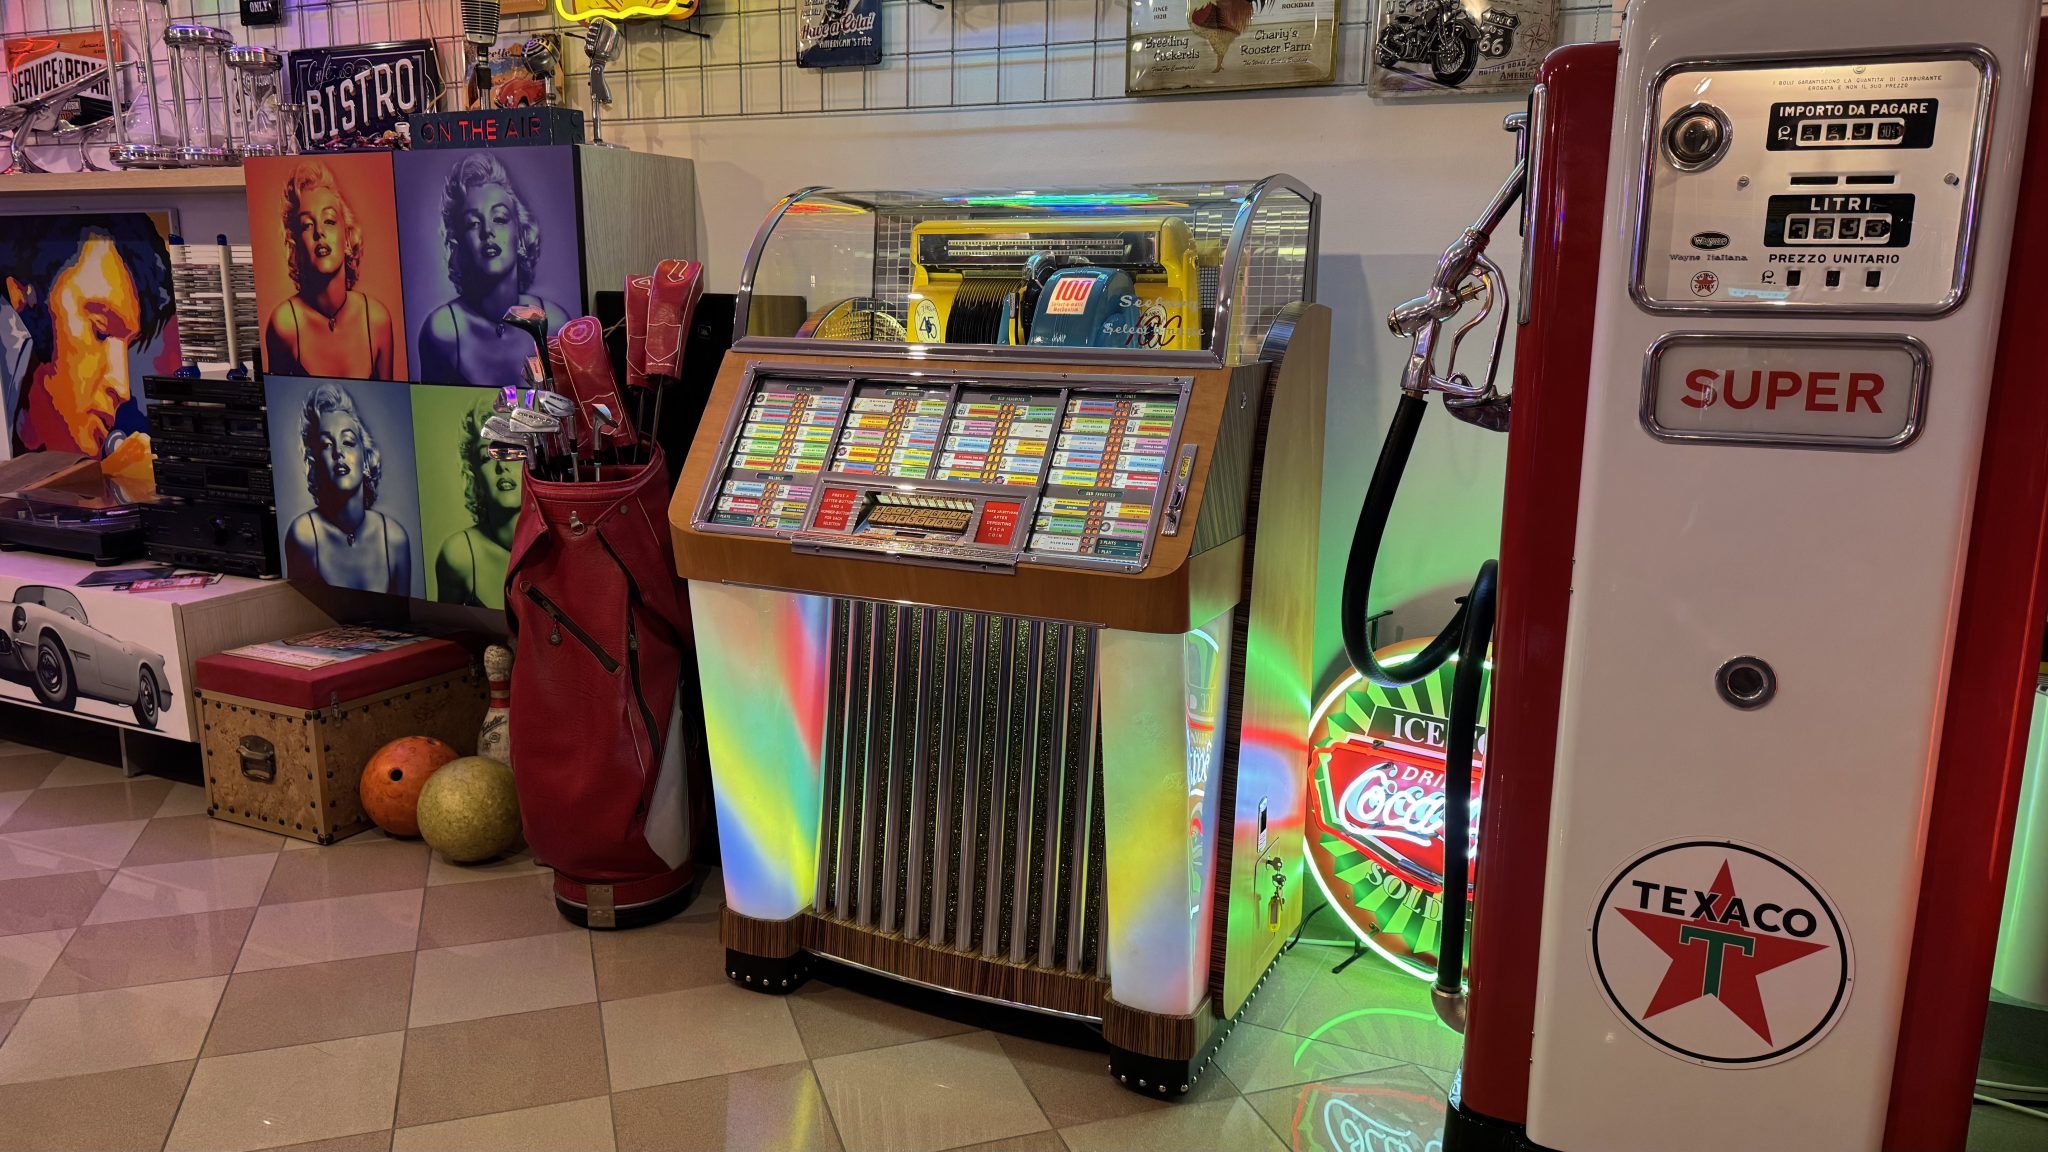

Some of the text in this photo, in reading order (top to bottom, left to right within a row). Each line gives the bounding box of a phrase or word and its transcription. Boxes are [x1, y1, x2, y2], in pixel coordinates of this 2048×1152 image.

[250, 1, 268, 12] ONLY
[802, 23, 830, 39] Have
[840, 12, 876, 34] Cola!
[1490, 14, 1514, 26] ROUTE
[1145, 36, 1190, 49] Breeding
[1240, 42, 1312, 56] Rooster Farm
[1479, 34, 1504, 56] 66
[1154, 48, 1200, 62] Cockerels
[12, 57, 58, 104] SERVICE
[306, 58, 416, 140] BISTRO
[1780, 102, 1928, 117] IMPORTO DA PAGARE
[420, 117, 542, 144] ON THE AIR
[1810, 197, 1871, 210] LITRI
[1768, 254, 1900, 264] PREZZO UNITARIO
[1055, 280, 1092, 300] 100
[919, 316, 938, 338] 45
[1680, 368, 1885, 414] SUPER
[1392, 714, 1445, 748] ICE
[1402, 766, 1446, 788] DRI
[1366, 862, 1444, 922] SOLD
[1632, 880, 1817, 938] TEXACO
